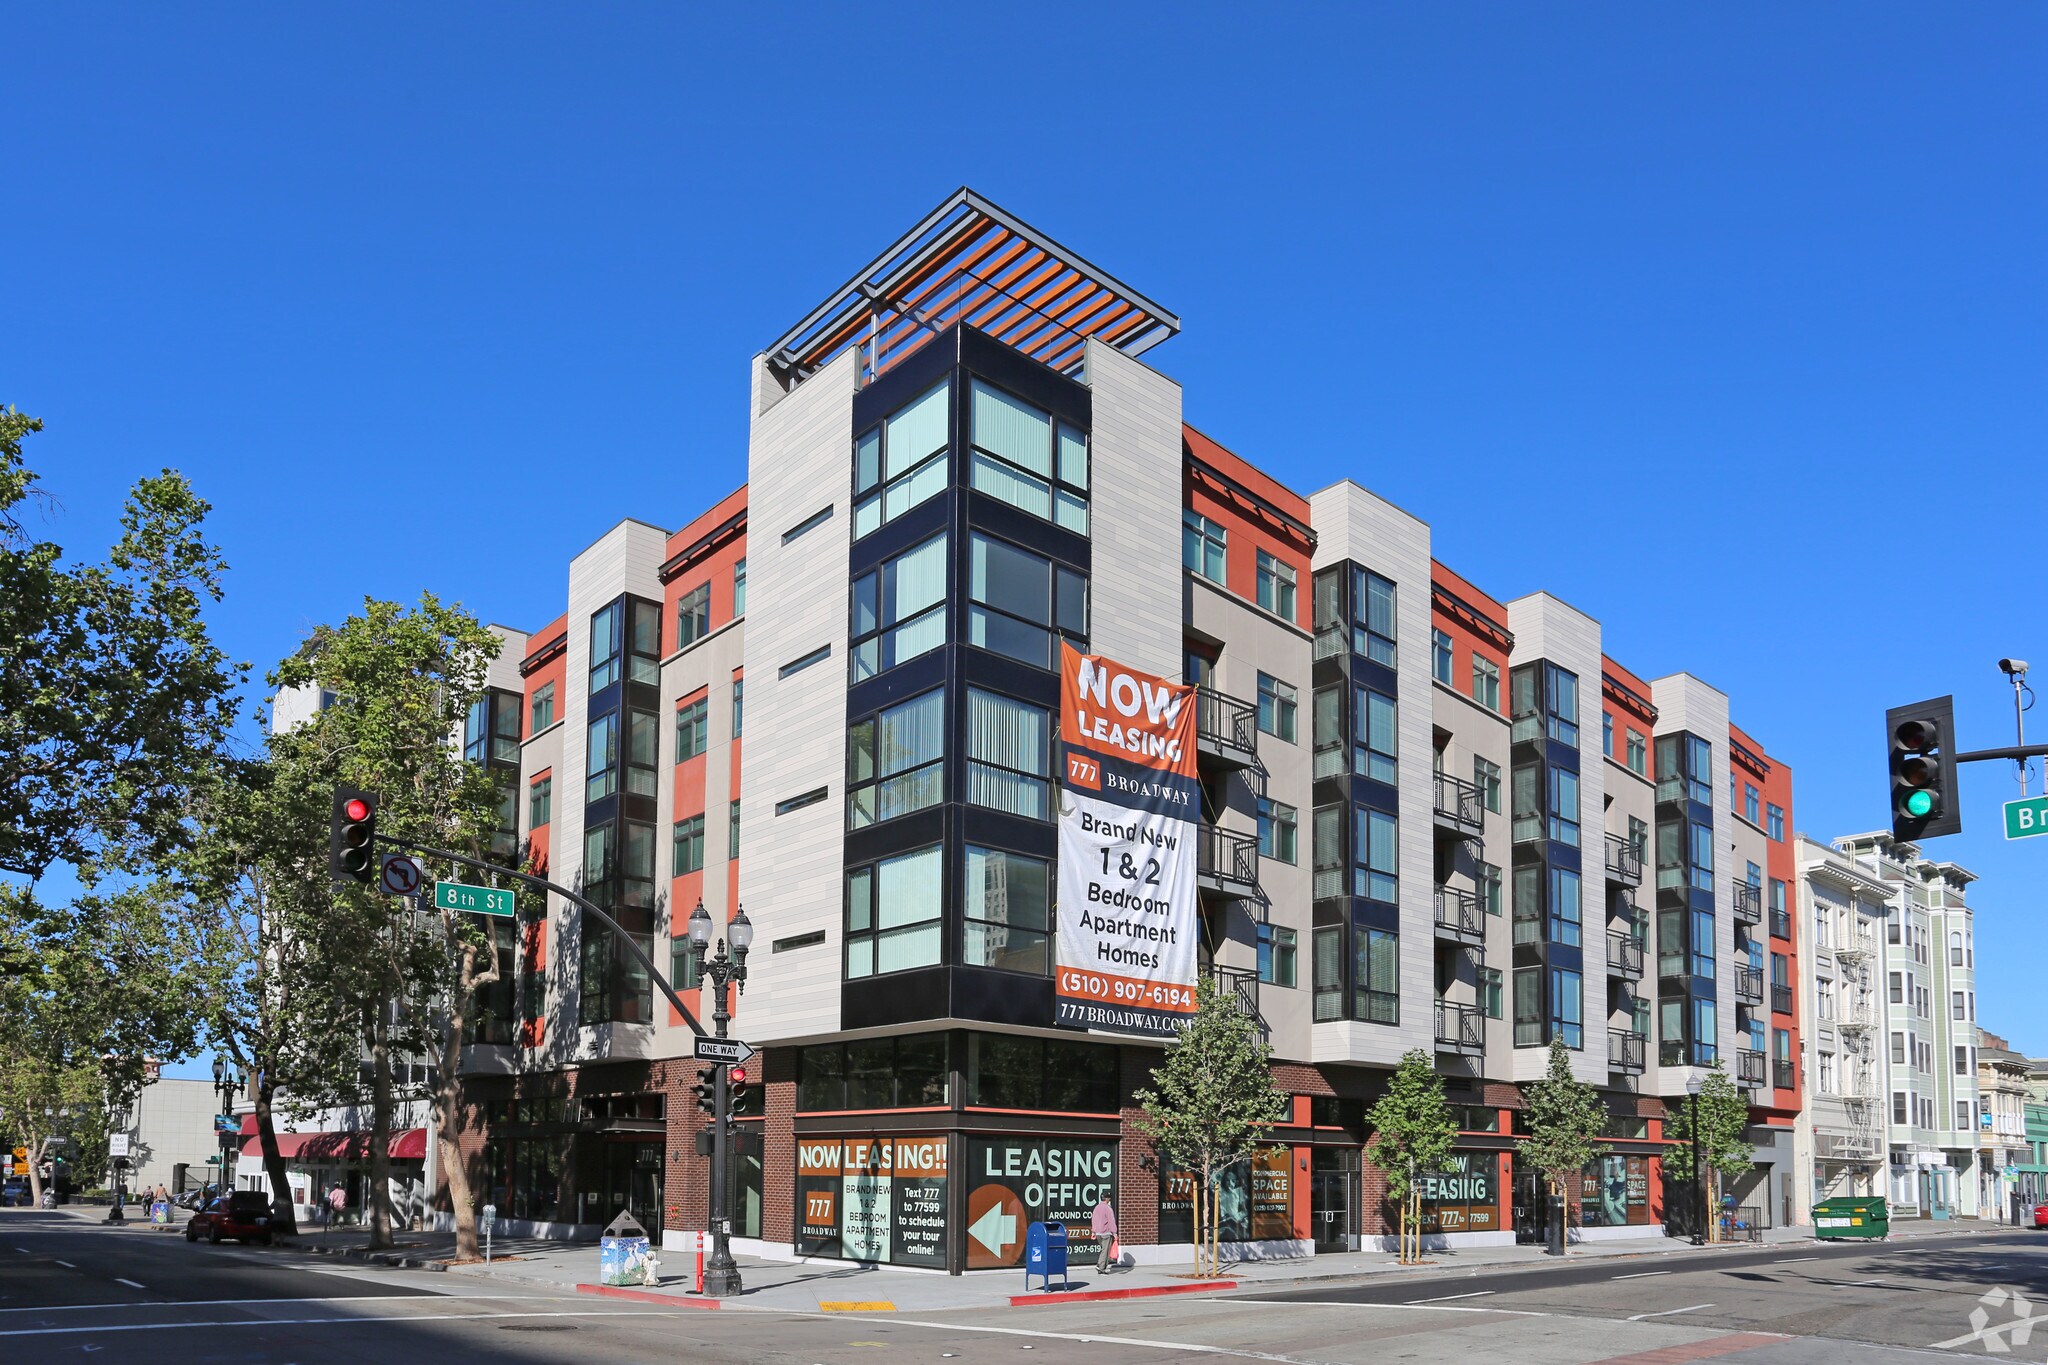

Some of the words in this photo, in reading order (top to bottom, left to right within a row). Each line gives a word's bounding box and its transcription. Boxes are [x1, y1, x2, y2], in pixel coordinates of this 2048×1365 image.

[1078, 658, 1182, 729] NOW
[1078, 710, 1181, 762] LEASING
[1071, 761, 1096, 781] 777
[1107, 773, 1190, 805] BROADWAY
[1081, 812, 1136, 842] Brand
[1141, 827, 1177, 850] New
[1101, 848, 1110, 875] 1
[1119, 852, 1138, 880] &
[1145, 858, 1160, 885] 2
[447, 889, 474, 907] 8th
[487, 894, 503, 910] St
[1087, 882, 1169, 916] Bedroom
[1079, 909, 1176, 944] Apartment
[1098, 941, 1159, 968] Homes
[1062, 972, 1109, 997] (510)
[1114, 981, 1191, 1006] 907-6194
[701, 1044, 717, 1053] ONE
[720, 1046, 737, 1055] WAY
[800, 1145, 842, 1168] NOW
[986, 1147, 1111, 1178] LEASING
[846, 1185, 871, 1194] BRAND
[872, 1185, 891, 1194] NEW
[1170, 1178, 1191, 1193] 777
[1253, 1179, 1287, 1190] SPACE
[1584, 1180, 1596, 1191] 777
[1627, 1180, 1645, 1189] SPACE
[905, 1188, 921, 1197] Text
[924, 1188, 939, 1198] 777
[809, 1199, 831, 1217] 777
[860, 1200, 863, 1208] 1
[865, 1200, 870, 1208] &
[871, 1200, 876, 1208] 2
[904, 1202, 912, 1211] to
[914, 1202, 940, 1212] 77599
[850, 1212, 886, 1222] BEDROOM
[1049, 1211, 1080, 1219] AROUND
[1419, 1214, 1437, 1224] EXT
[1442, 1211, 1459, 1225] 777
[1470, 1213, 1489, 1223] 77599
[899, 1215, 907, 1225] to
[908, 1216, 945, 1227] schedule
[802, 1227, 837, 1236] BROADWAY
[846, 1227, 889, 1237] APARTMENT
[903, 1231, 920, 1241] your
[922, 1230, 940, 1241] tour
[854, 1240, 880, 1250] HOMES
[907, 1244, 935, 1255] online!
[1074, 1245, 1102, 1253] 907-619
